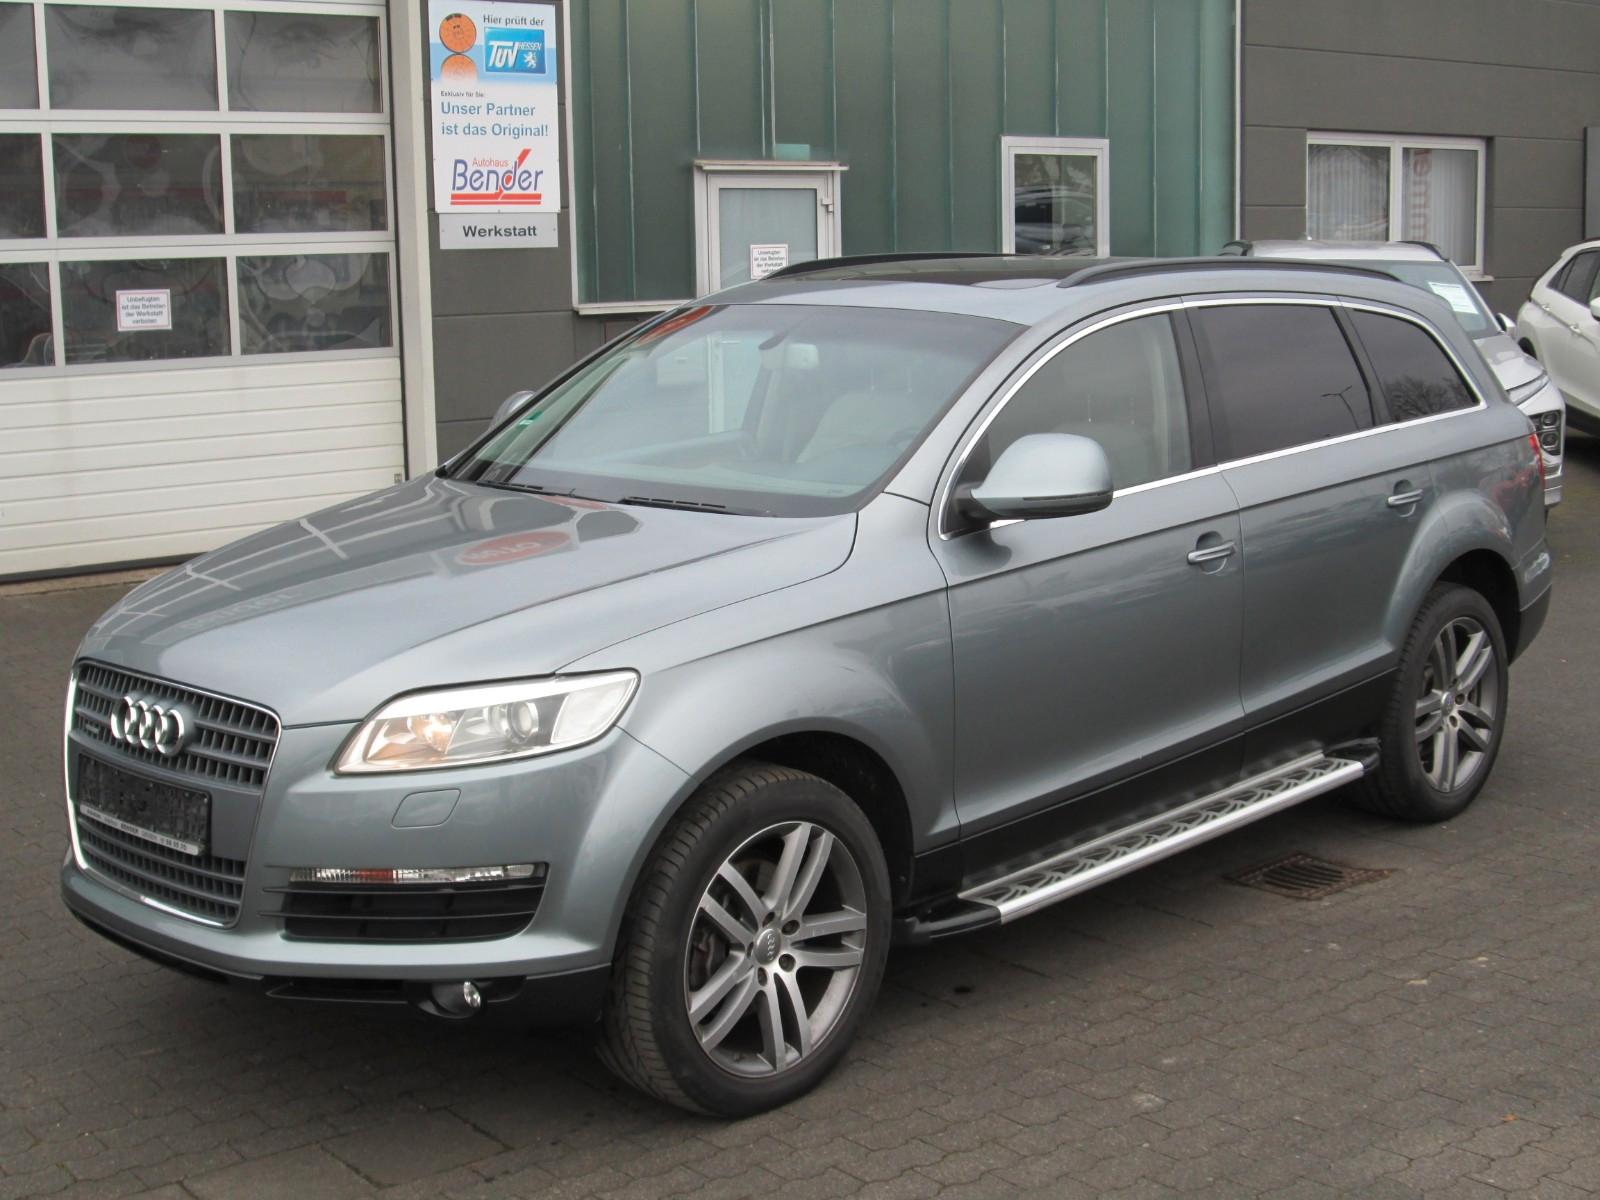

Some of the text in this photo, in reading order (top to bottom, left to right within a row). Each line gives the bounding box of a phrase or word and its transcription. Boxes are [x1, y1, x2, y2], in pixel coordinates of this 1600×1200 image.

[483, 14, 545, 26] Hier prüft der
[441, 101, 536, 116] Unser Partner
[441, 122, 548, 140] ist das Original!
[472, 158, 509, 168] Autohaus
[451, 157, 544, 191] Bender
[463, 225, 537, 237] Werkstatt
